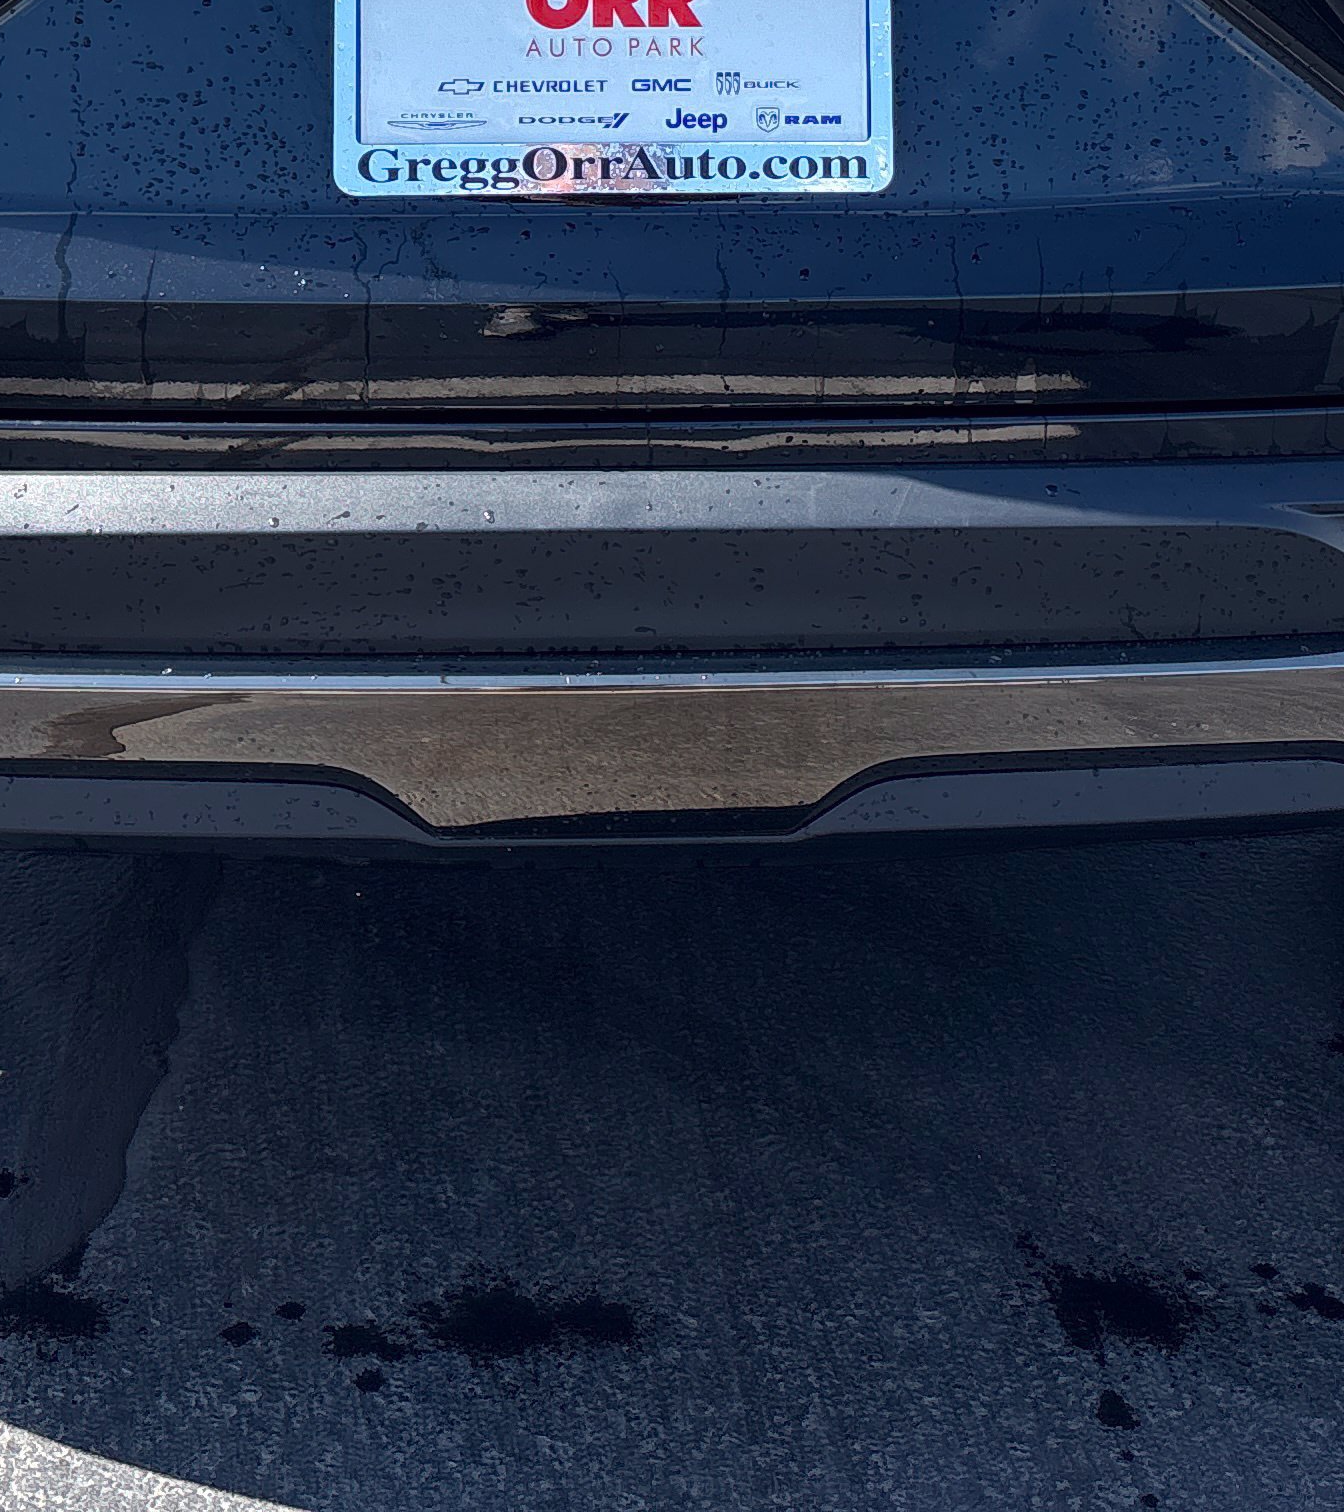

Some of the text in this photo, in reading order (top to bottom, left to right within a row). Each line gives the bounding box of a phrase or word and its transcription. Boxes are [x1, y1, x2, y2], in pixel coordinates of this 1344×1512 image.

[526, 37, 705, 58] AUTO PARK
[492, 78, 800, 94] CHEVROLET GMC BUICK
[400, 108, 842, 133] CHRYSLER DODGE Jeep RAM
[357, 146, 869, 191] GreggOrrAuto.com
